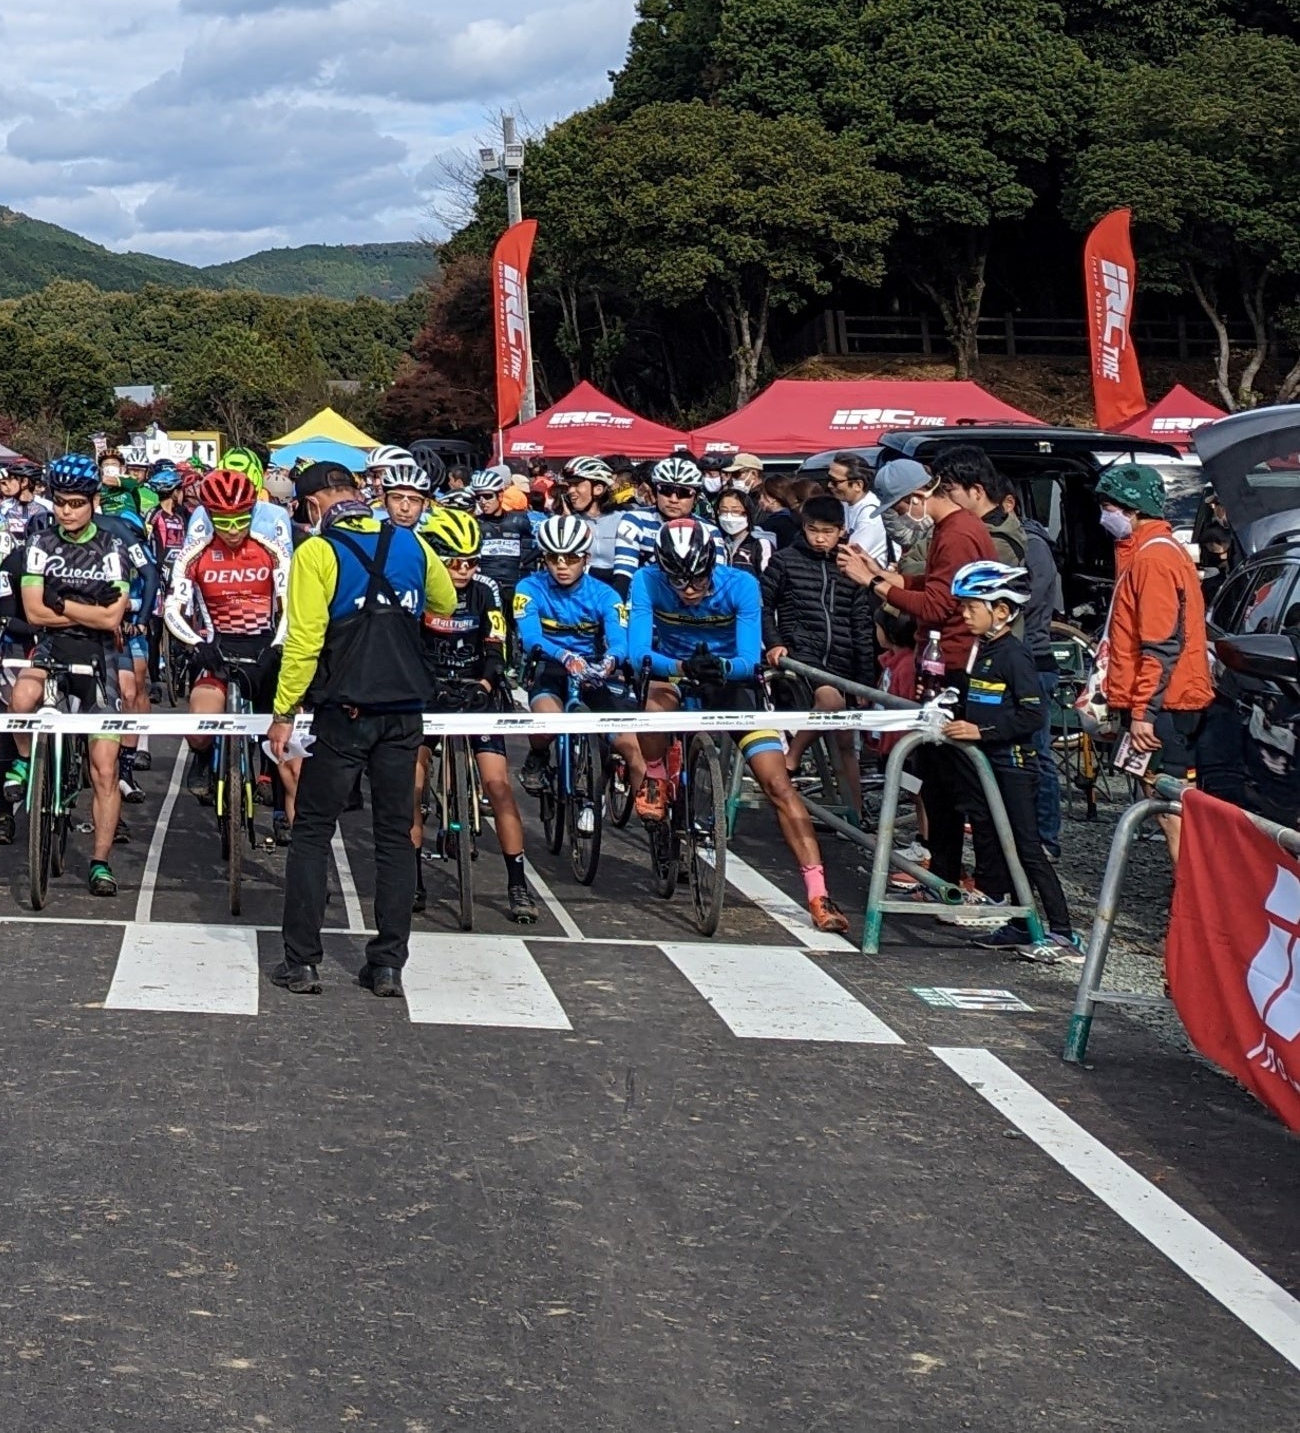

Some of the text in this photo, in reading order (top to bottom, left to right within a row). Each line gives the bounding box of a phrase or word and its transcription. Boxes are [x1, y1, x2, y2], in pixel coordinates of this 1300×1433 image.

[510, 346, 523, 382] TIRE
[1102, 345, 1120, 383] TIRE
[913, 416, 947, 427] TIRE
[45, 555, 106, 581] Rueda
[203, 567, 270, 583] DENSO
[277, 571, 285, 588] 2
[180, 581, 188, 596] 2
